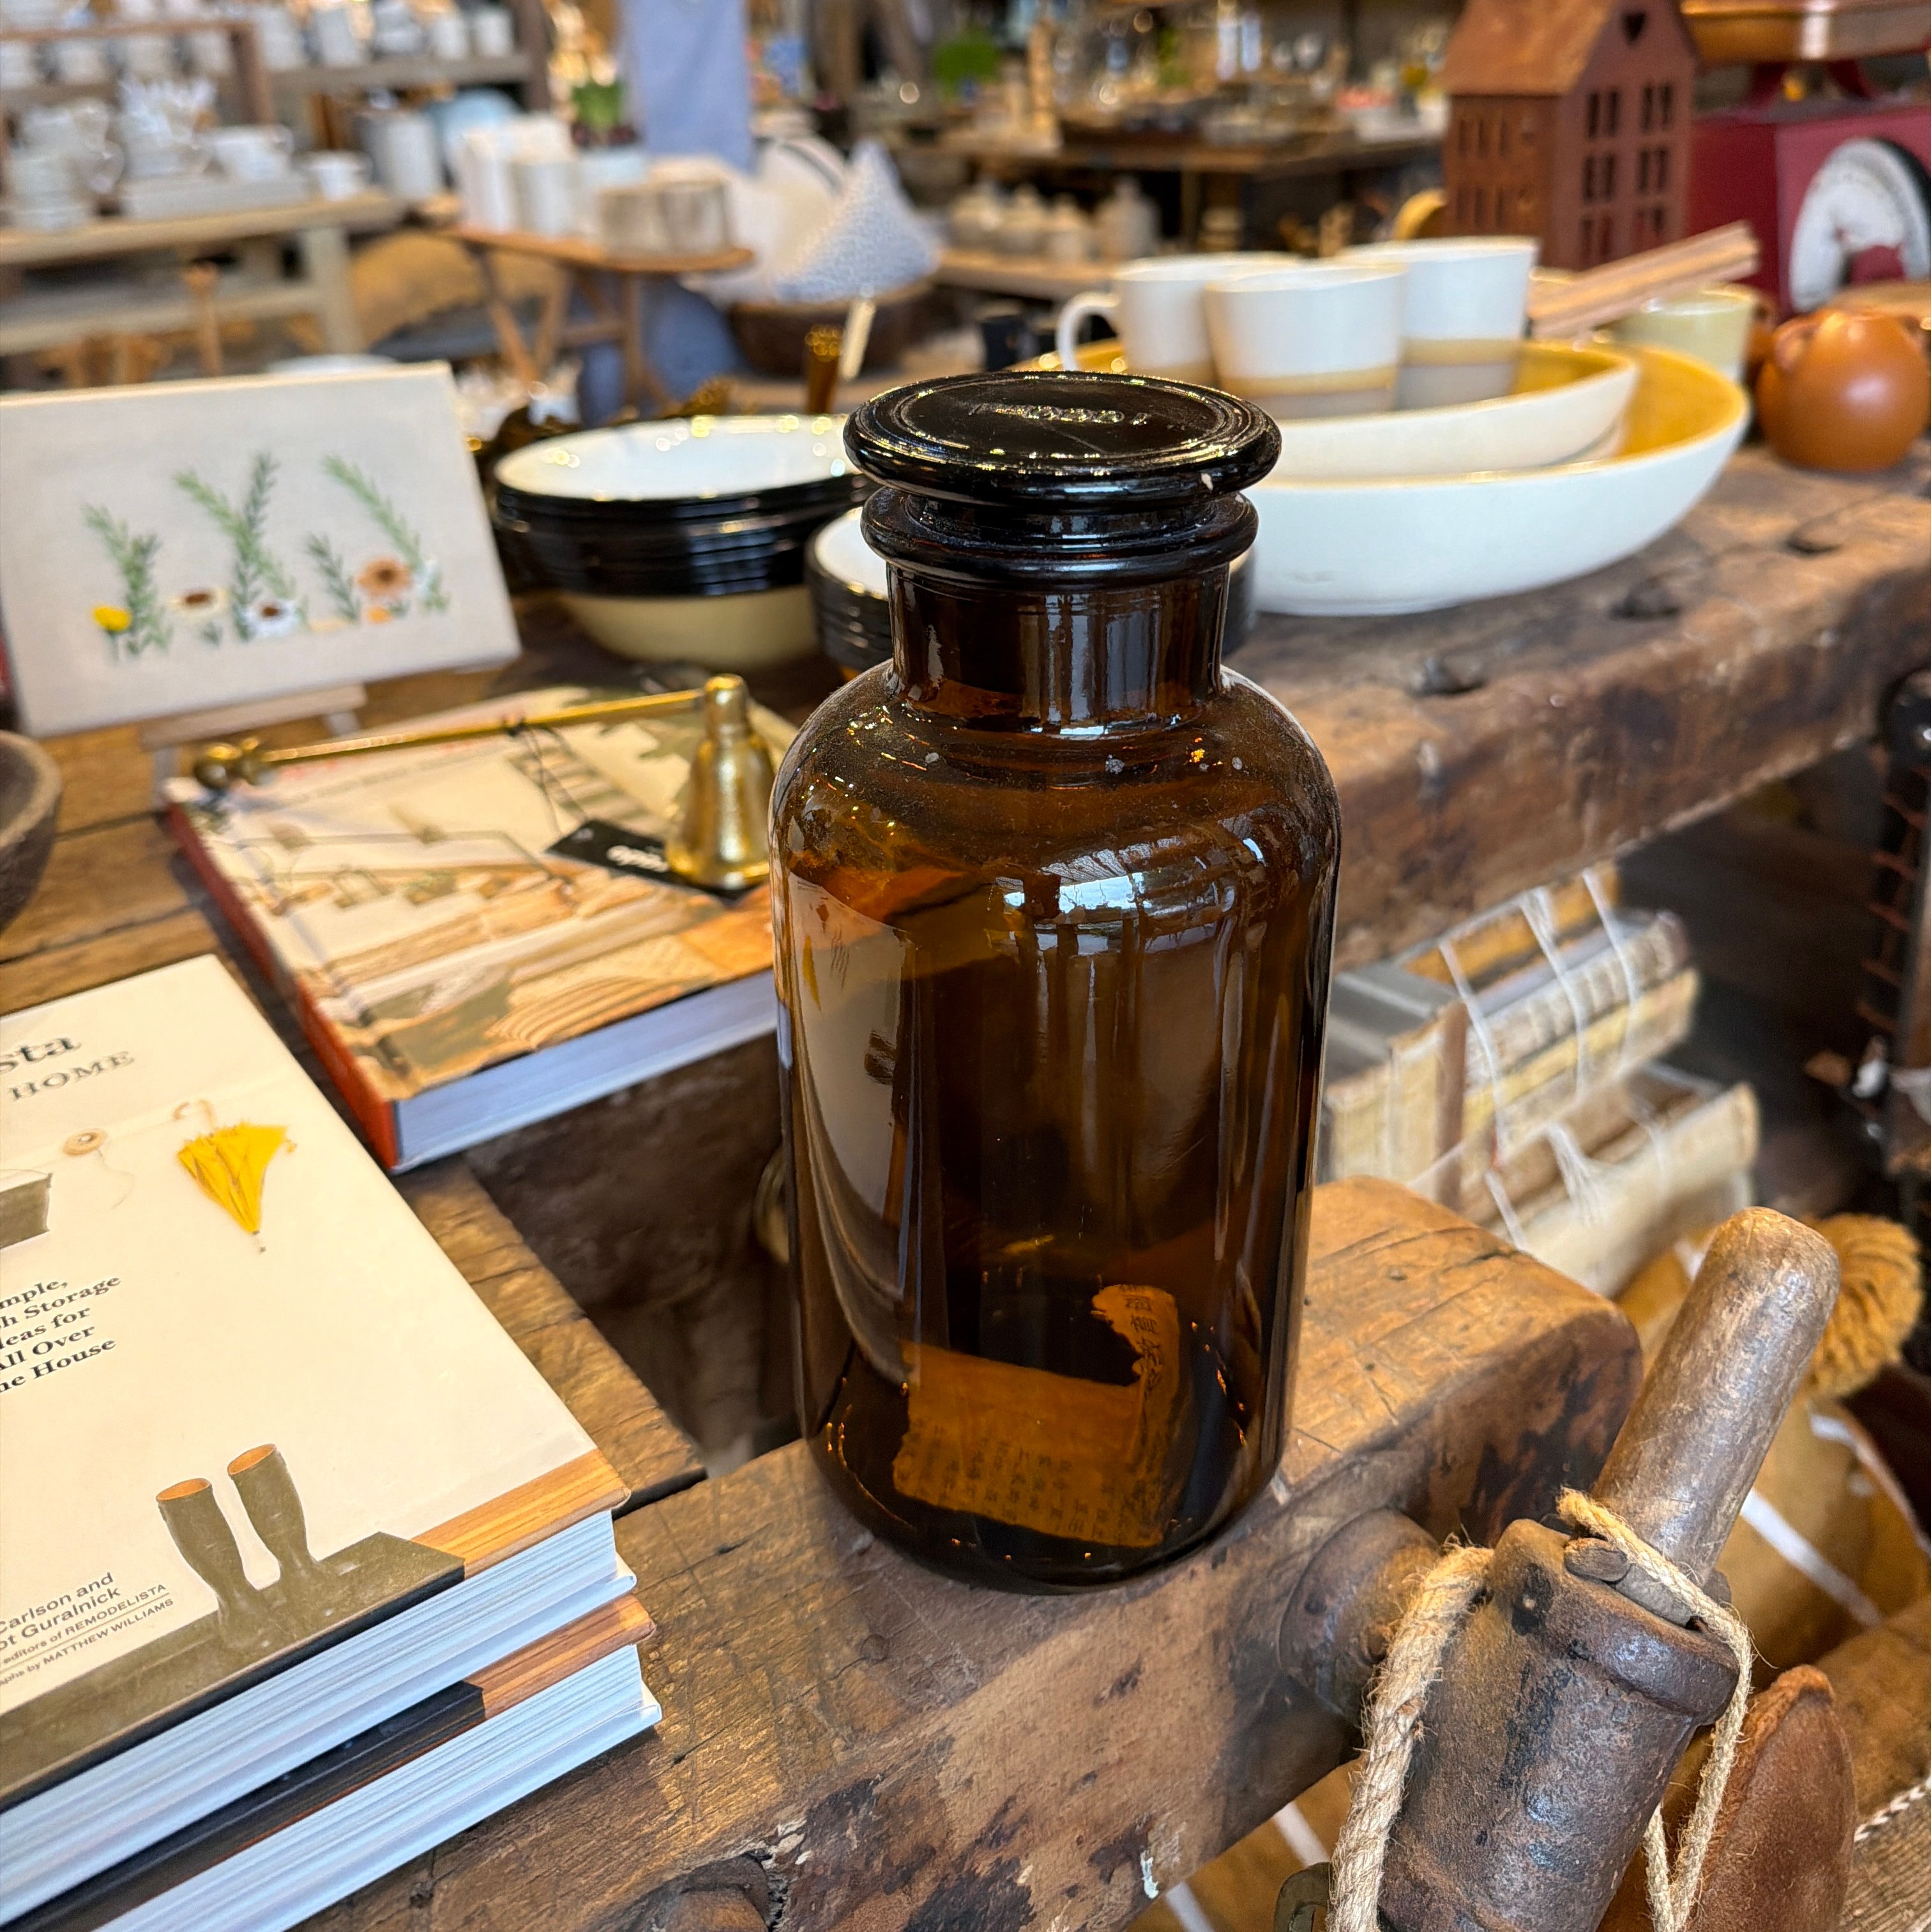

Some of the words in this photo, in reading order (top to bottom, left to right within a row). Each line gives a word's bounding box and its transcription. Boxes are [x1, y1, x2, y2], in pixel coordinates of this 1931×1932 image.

[8, 1051, 135, 1102] HOME
[0, 1316, 19, 1328] h
[24, 1277, 121, 1320] Storage
[51, 1307, 91, 1328] for
[30, 1340, 116, 1379] House
[32, 1327, 95, 1355] Over
[76, 1572, 114, 1597] and
[4, 1640, 47, 1664] editors
[50, 1631, 61, 1642] of
[65, 1585, 167, 1635] REMODELISTA
[21, 1588, 121, 1638] Guralnick
[27, 1661, 40, 1672] by
[43, 1629, 109, 1664] MATTHEW
[110, 1599, 174, 1632] WILLIAMS
